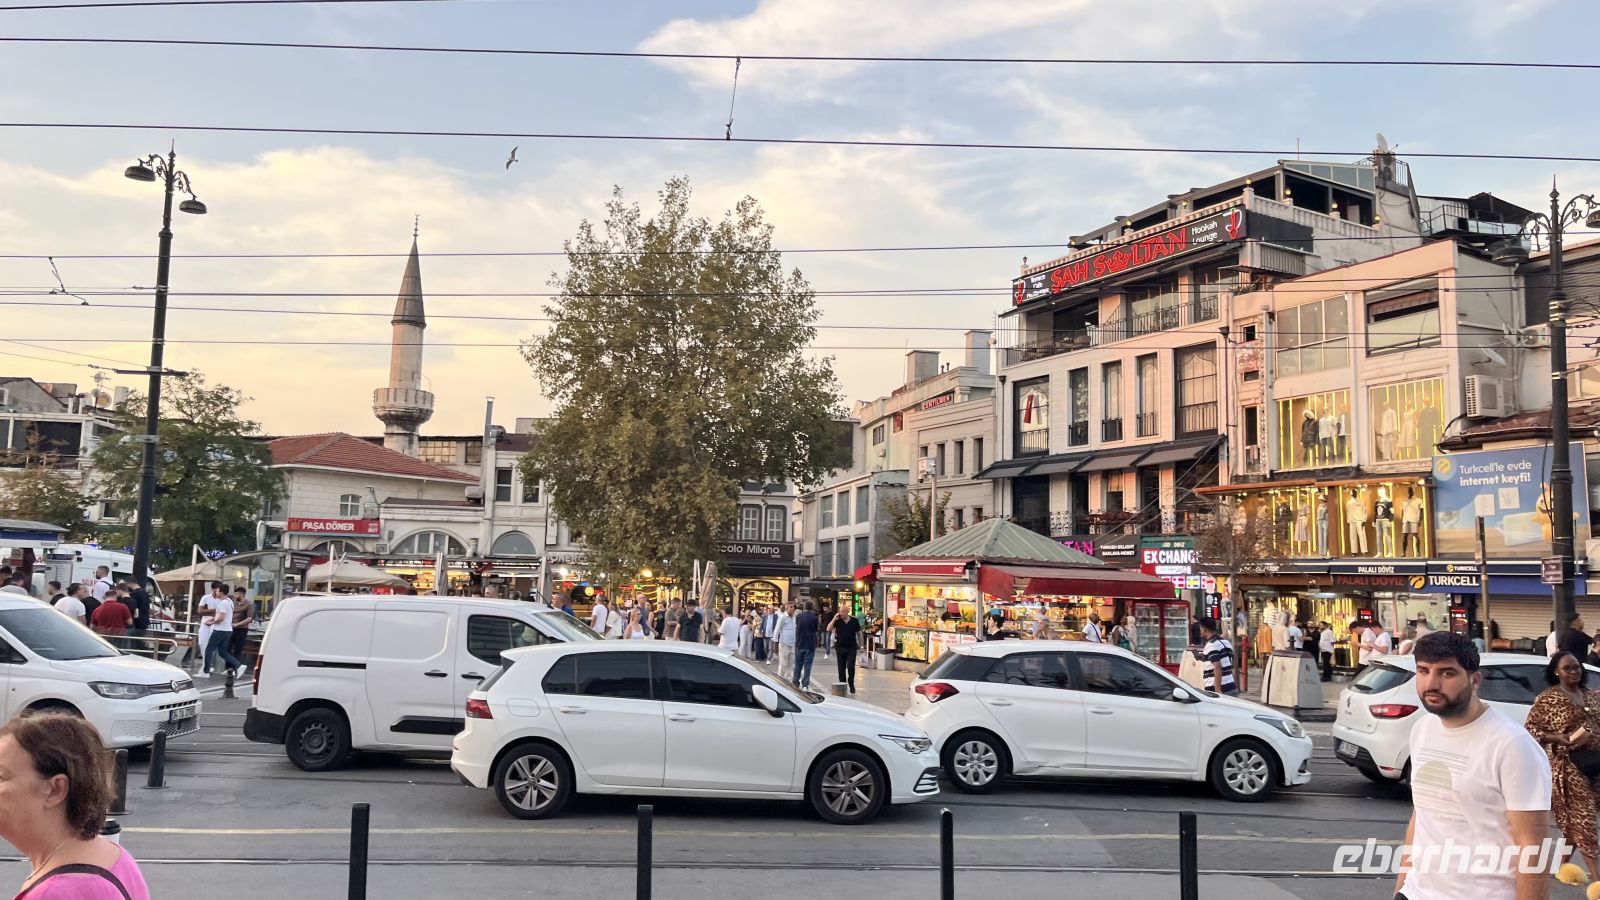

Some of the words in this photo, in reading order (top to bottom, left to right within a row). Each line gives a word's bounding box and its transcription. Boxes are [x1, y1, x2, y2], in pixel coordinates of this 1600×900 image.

[1191, 220, 1218, 236] Hookah
[1192, 232, 1218, 246] Lounge
[1459, 462, 1505, 475] Turkcell'le
[1507, 460, 1532, 471] evde
[1459, 475, 1499, 487] internet
[1501, 472, 1531, 485] keyfi!
[302, 521, 325, 532] PAŞA
[326, 521, 355, 531] DÖNER
[746, 544, 780, 554] Milano
[1428, 575, 1479, 586] TURKCELL
